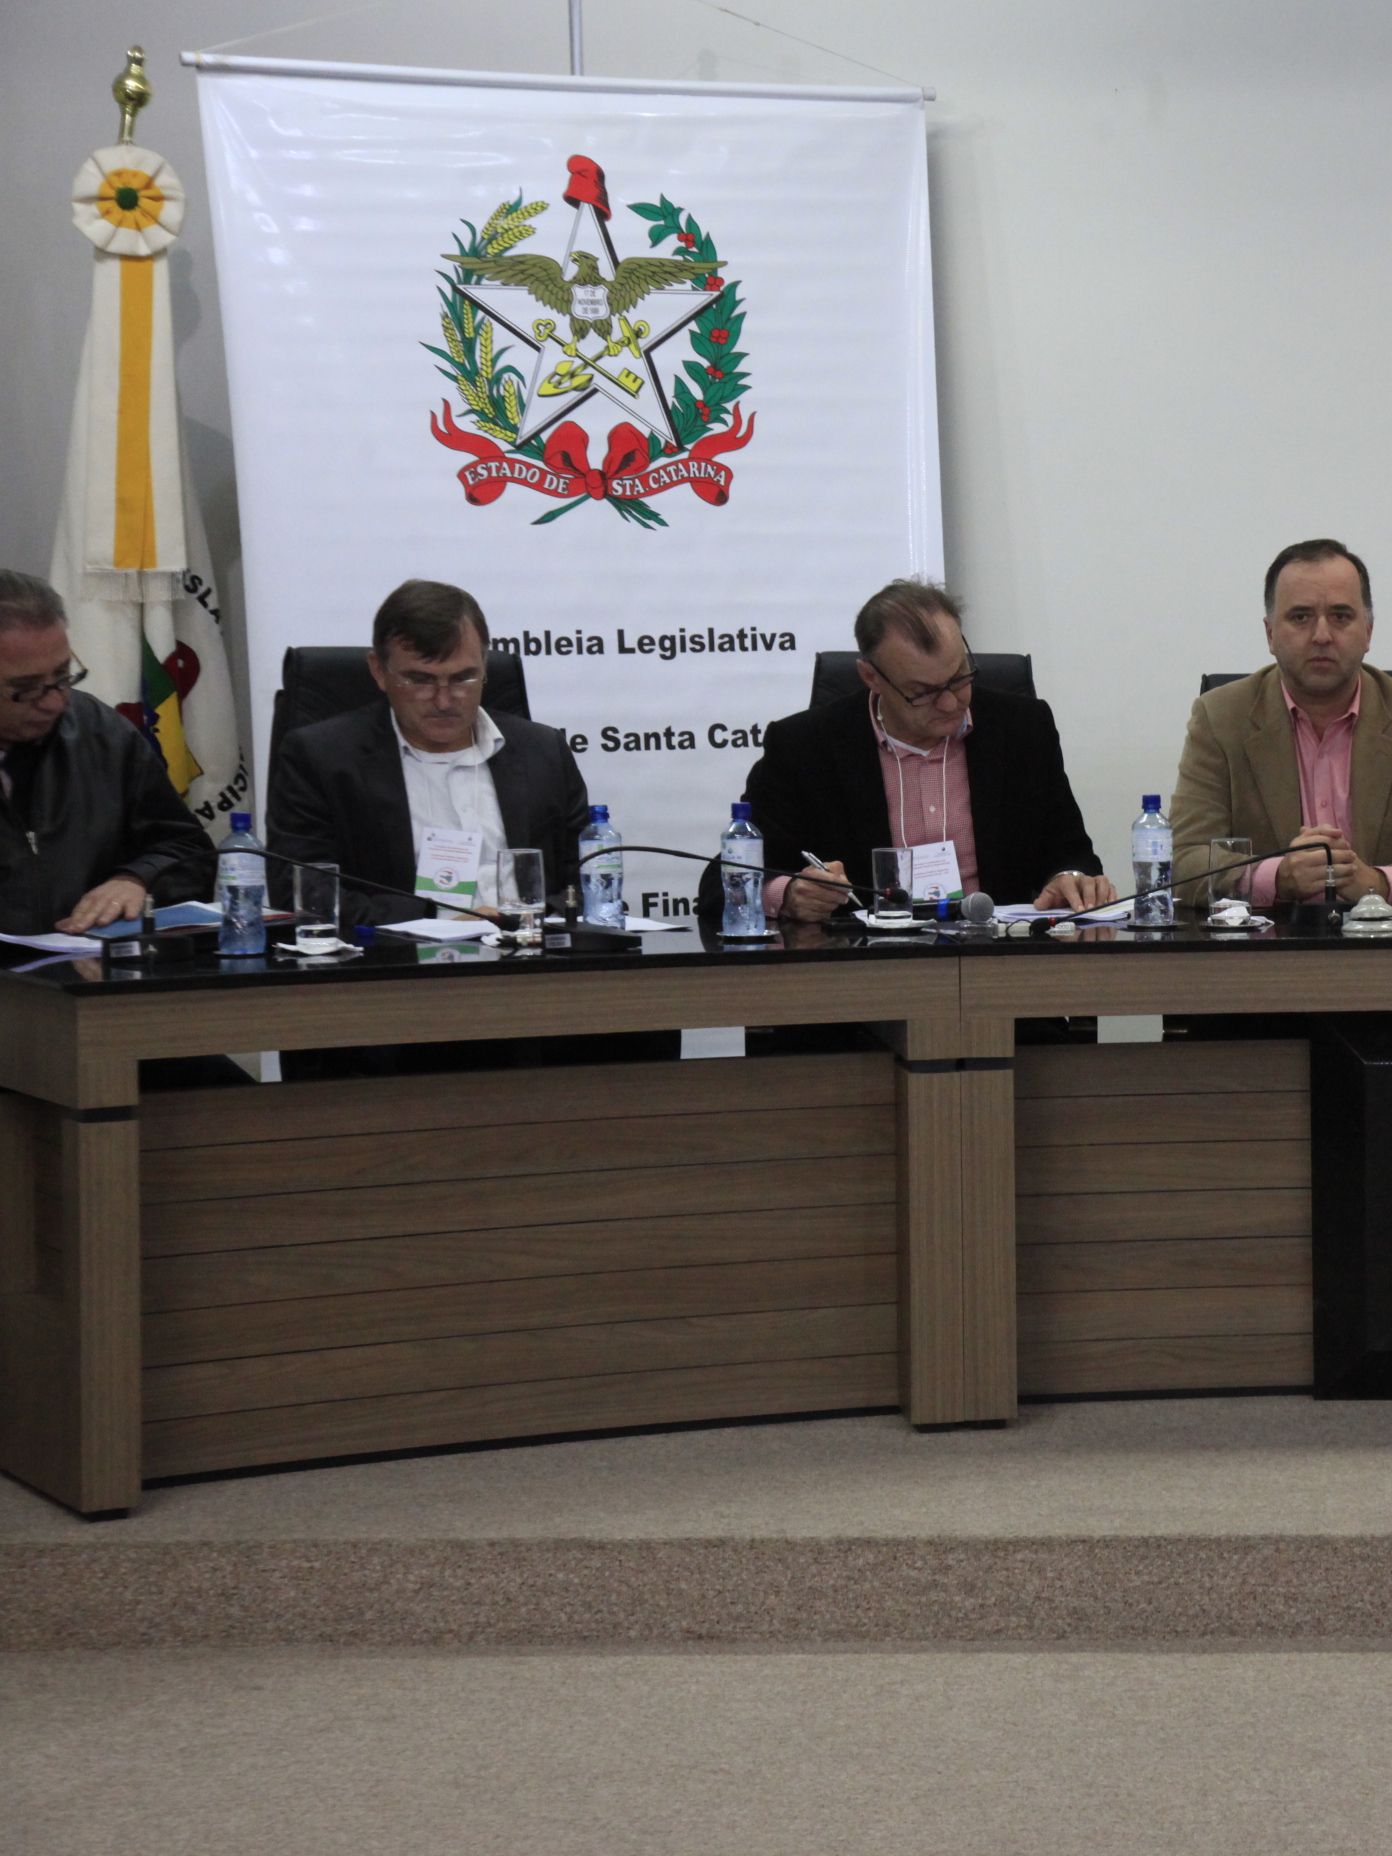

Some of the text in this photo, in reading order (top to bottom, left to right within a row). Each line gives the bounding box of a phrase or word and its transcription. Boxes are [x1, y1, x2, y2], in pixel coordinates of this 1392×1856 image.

[465, 460, 727, 497] ESTADO DE STA. CATARINA
[491, 626, 797, 661] mbleia Legislativa
[600, 724, 696, 753] Santa
[707, 722, 764, 749] Cat
